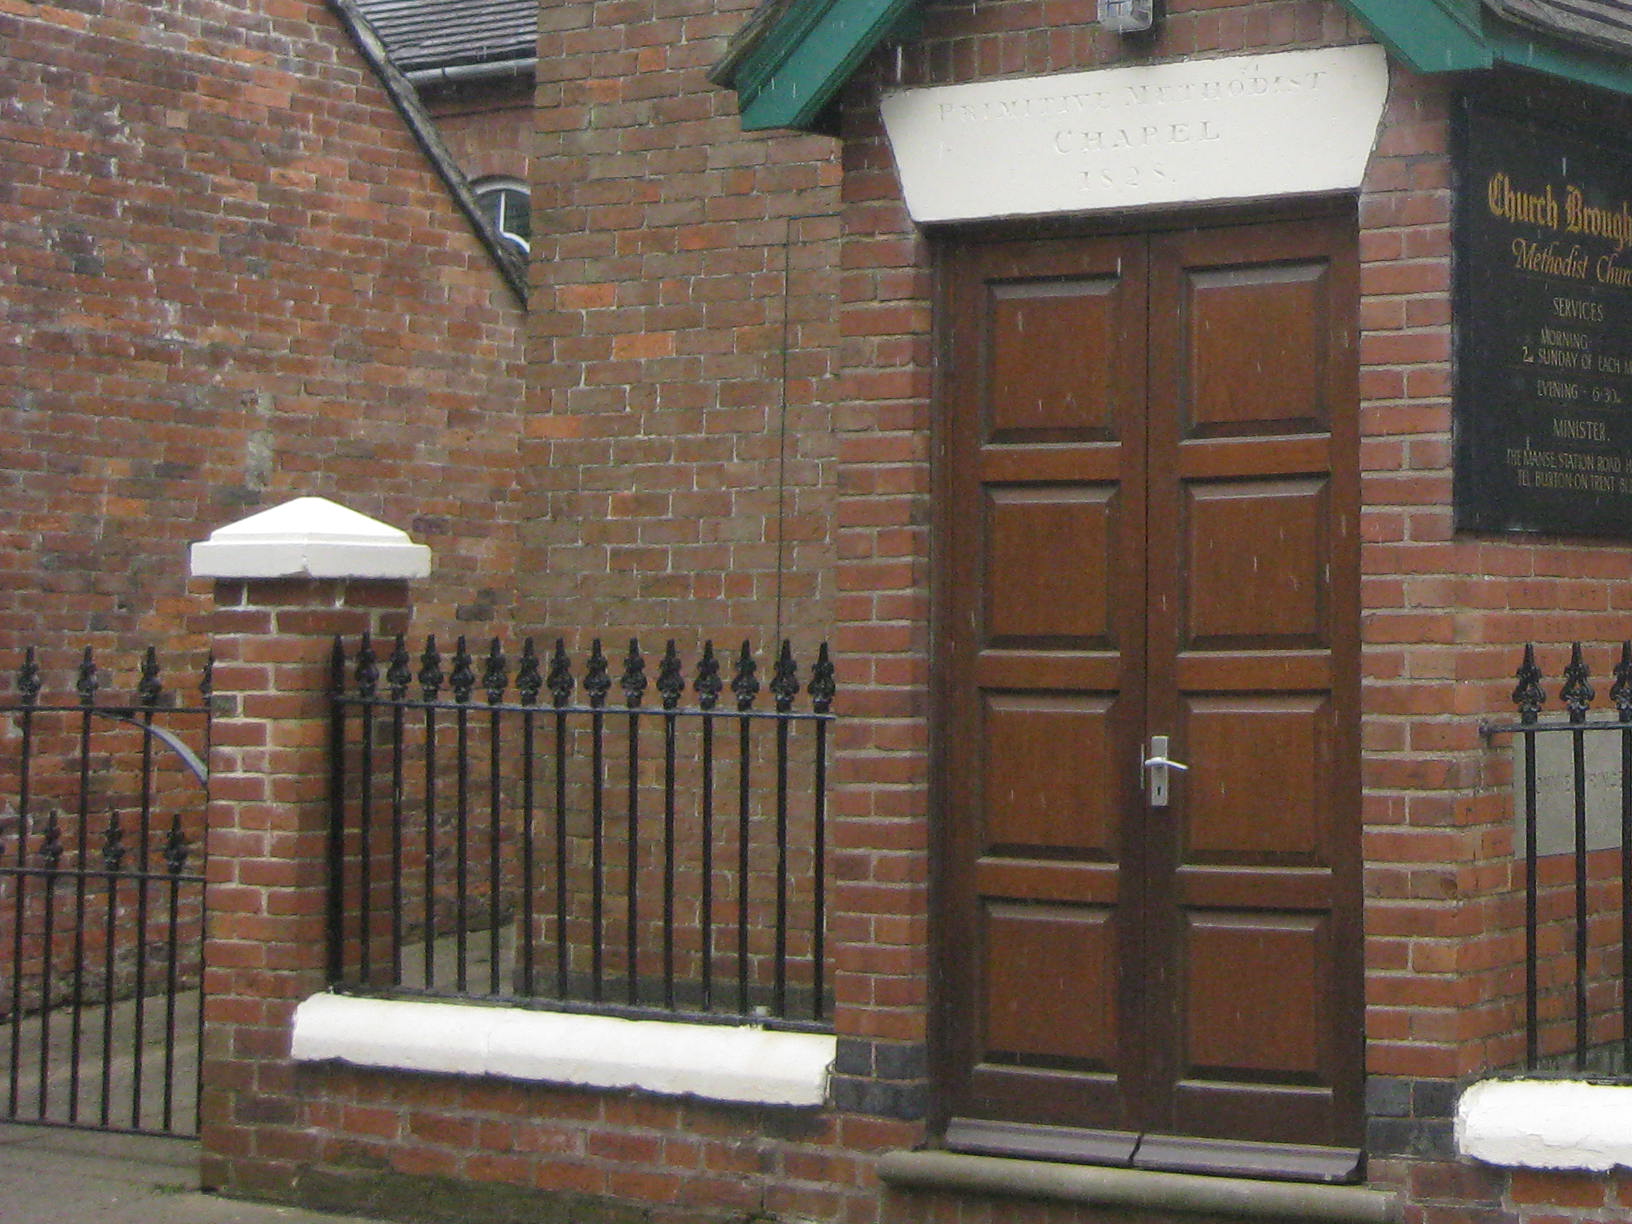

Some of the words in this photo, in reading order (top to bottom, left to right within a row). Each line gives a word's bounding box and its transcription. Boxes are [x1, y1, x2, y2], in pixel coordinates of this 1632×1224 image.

[1125, 70, 1329, 107] METHODIST
[1054, 119, 1222, 155] CHAPEL
[1488, 172, 1560, 231] Church
[1511, 237, 1590, 280] Methodist
[1552, 296, 1605, 323] SERVICES
[1538, 348, 1579, 368] SUNDAY
